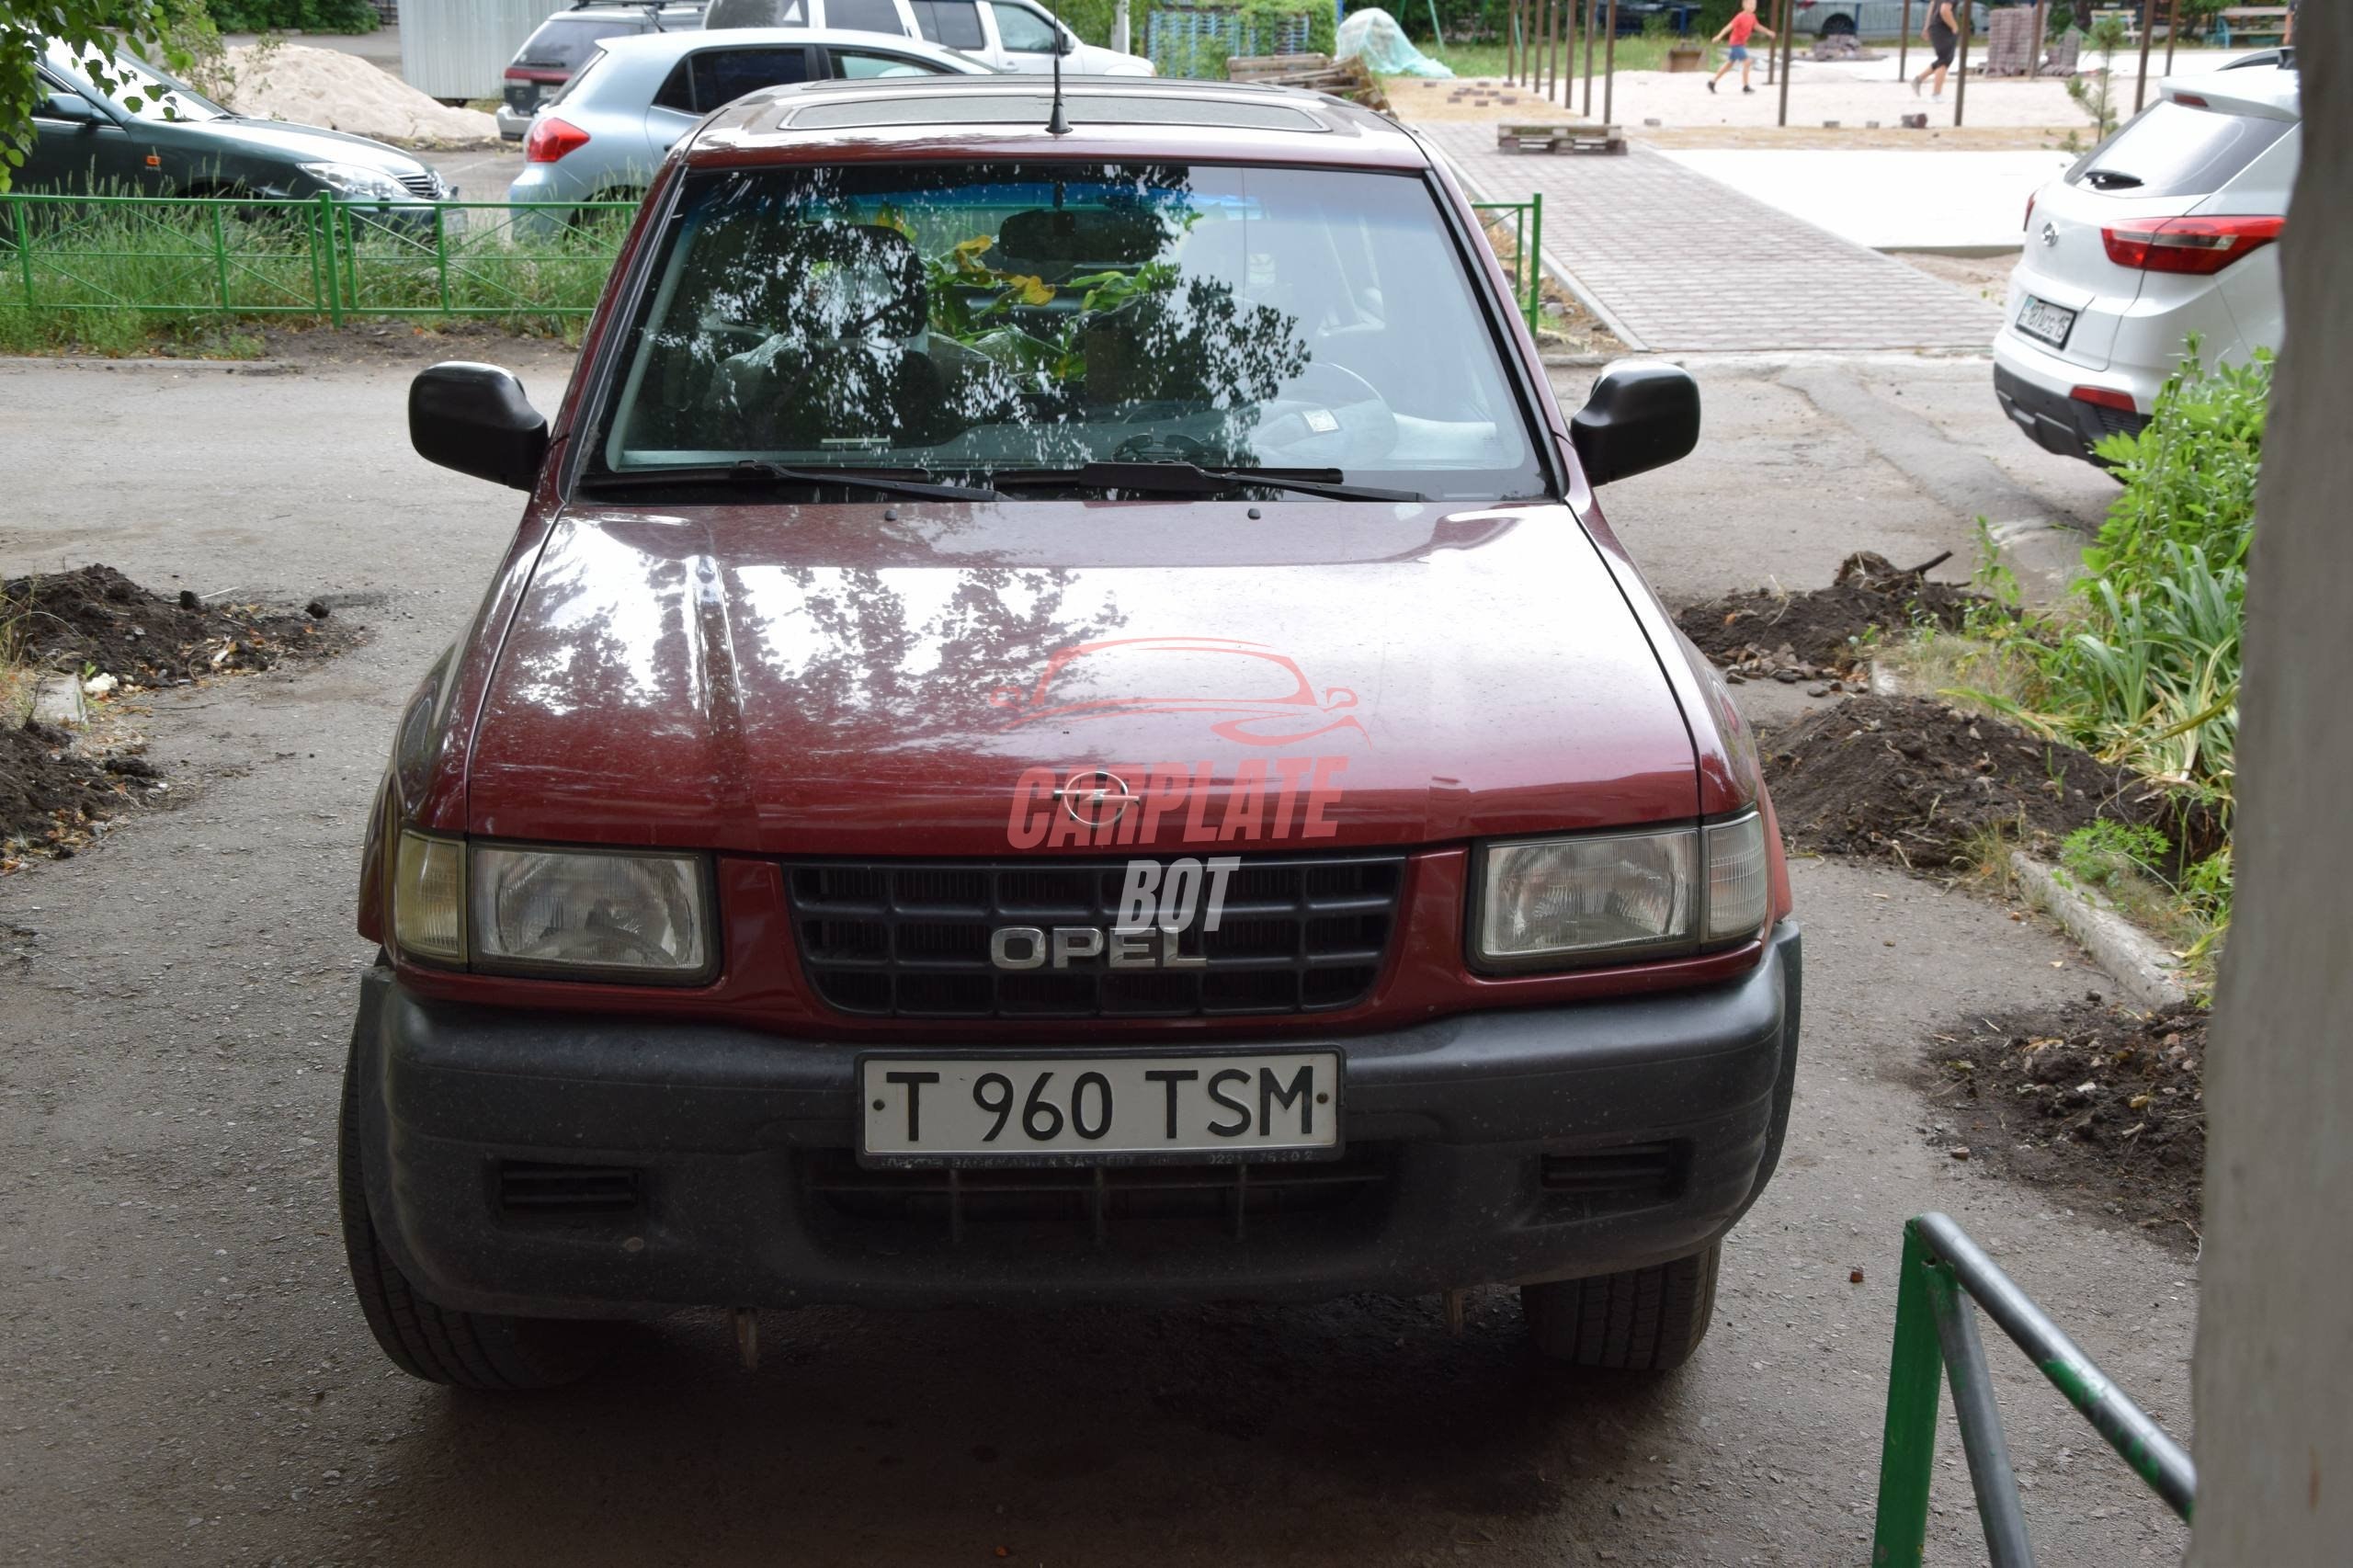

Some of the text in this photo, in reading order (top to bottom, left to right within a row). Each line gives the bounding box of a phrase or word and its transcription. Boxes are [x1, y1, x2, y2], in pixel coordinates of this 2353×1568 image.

[990, 926, 1207, 969] OPEL
[886, 1065, 1313, 1142] T 960 TSM
